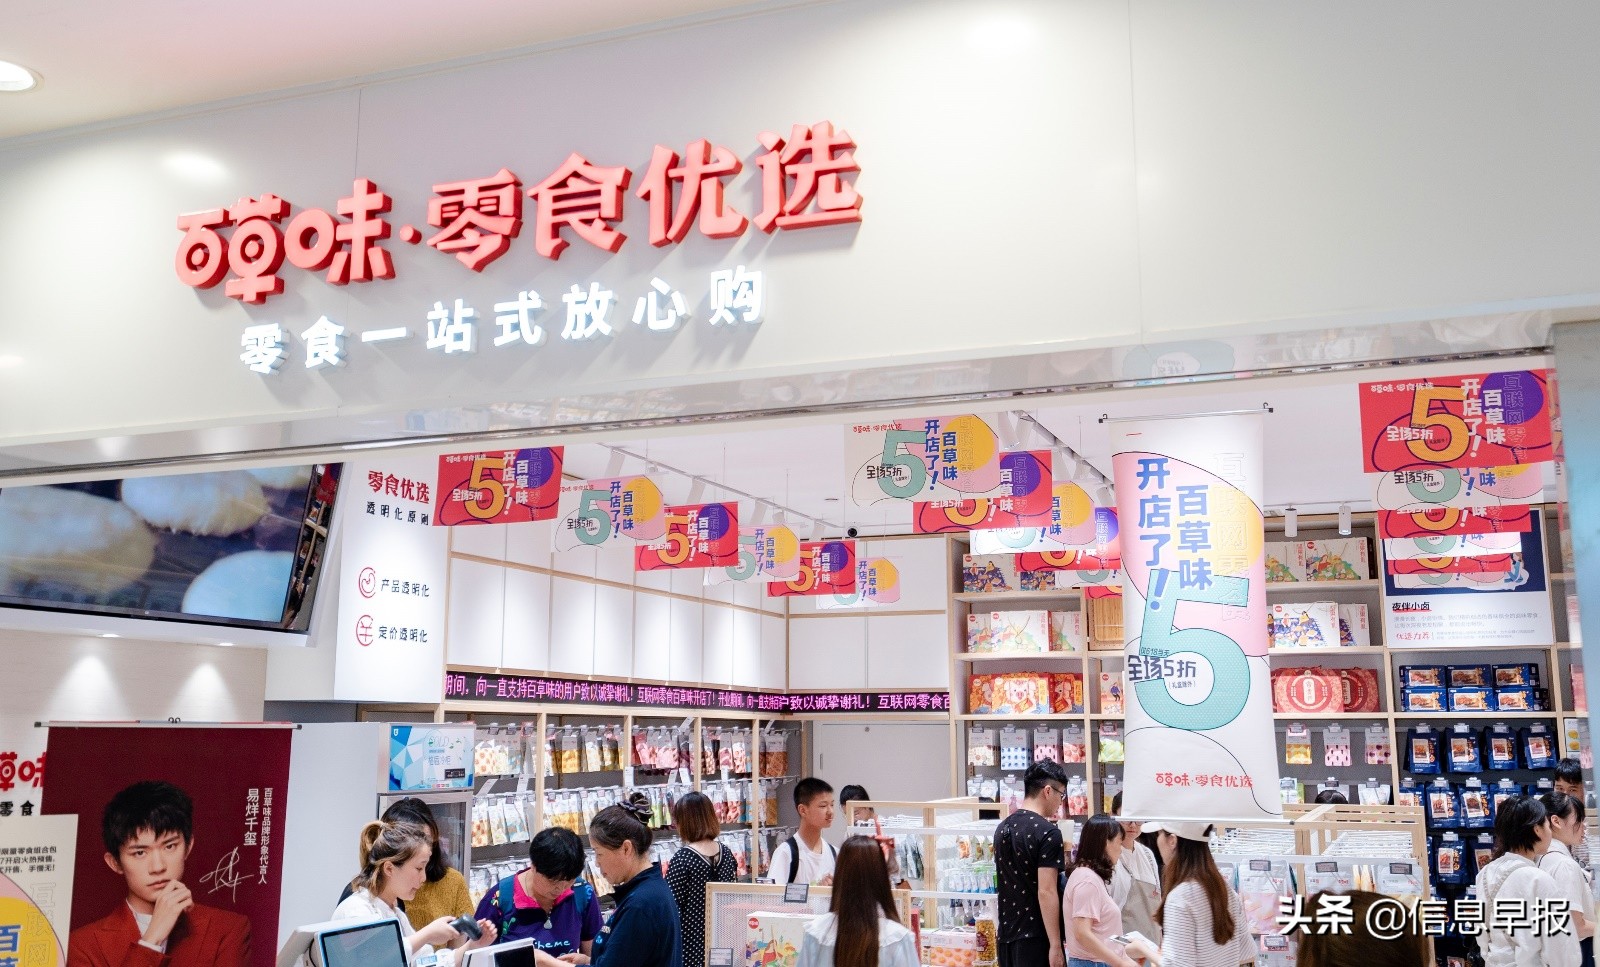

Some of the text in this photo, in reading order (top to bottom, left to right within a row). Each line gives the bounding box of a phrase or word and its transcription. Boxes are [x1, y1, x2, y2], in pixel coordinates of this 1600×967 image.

[175, 120, 863, 304] 百草味·零食优选
[240, 266, 766, 376] 零食一站式放心购
[1386, 425, 1434, 442] 全场5折
[1405, 385, 1470, 463] 5
[1460, 378, 1483, 458] 开店了！
[1483, 389, 1506, 445] 百草味
[866, 465, 902, 479] 全场5折
[876, 430, 927, 499] 5
[925, 420, 940, 491] 开店了！
[942, 431, 958, 481] 百草味
[367, 470, 430, 504] 零食优选
[452, 488, 483, 502] 全场5折
[463, 458, 507, 519] 5
[502, 451, 516, 515] 开店了！
[515, 459, 529, 505] 百草味
[1000, 468, 1014, 513] 百草味
[366, 501, 430, 526] 透明化原则
[574, 489, 612, 546] 5
[610, 481, 621, 539] 开店了！
[622, 491, 634, 531] 百草味
[698, 517, 709, 553] 百草味
[1135, 457, 1171, 611] 开店了！
[766, 537, 775, 570] 百草味
[1176, 484, 1213, 591] 百草味
[380, 578, 430, 599] 产品透明化
[821, 552, 831, 584] 百草味
[868, 568, 877, 596] 百草味
[378, 626, 428, 643] 定价透明化
[1133, 568, 1252, 731] 5
[1127, 654, 1197, 682] 全场5折
[243, 788, 260, 846] 易烊千玺
[258, 787, 274, 885] 百草味品牌形象代言人
[534, 940, 571, 950] heme
